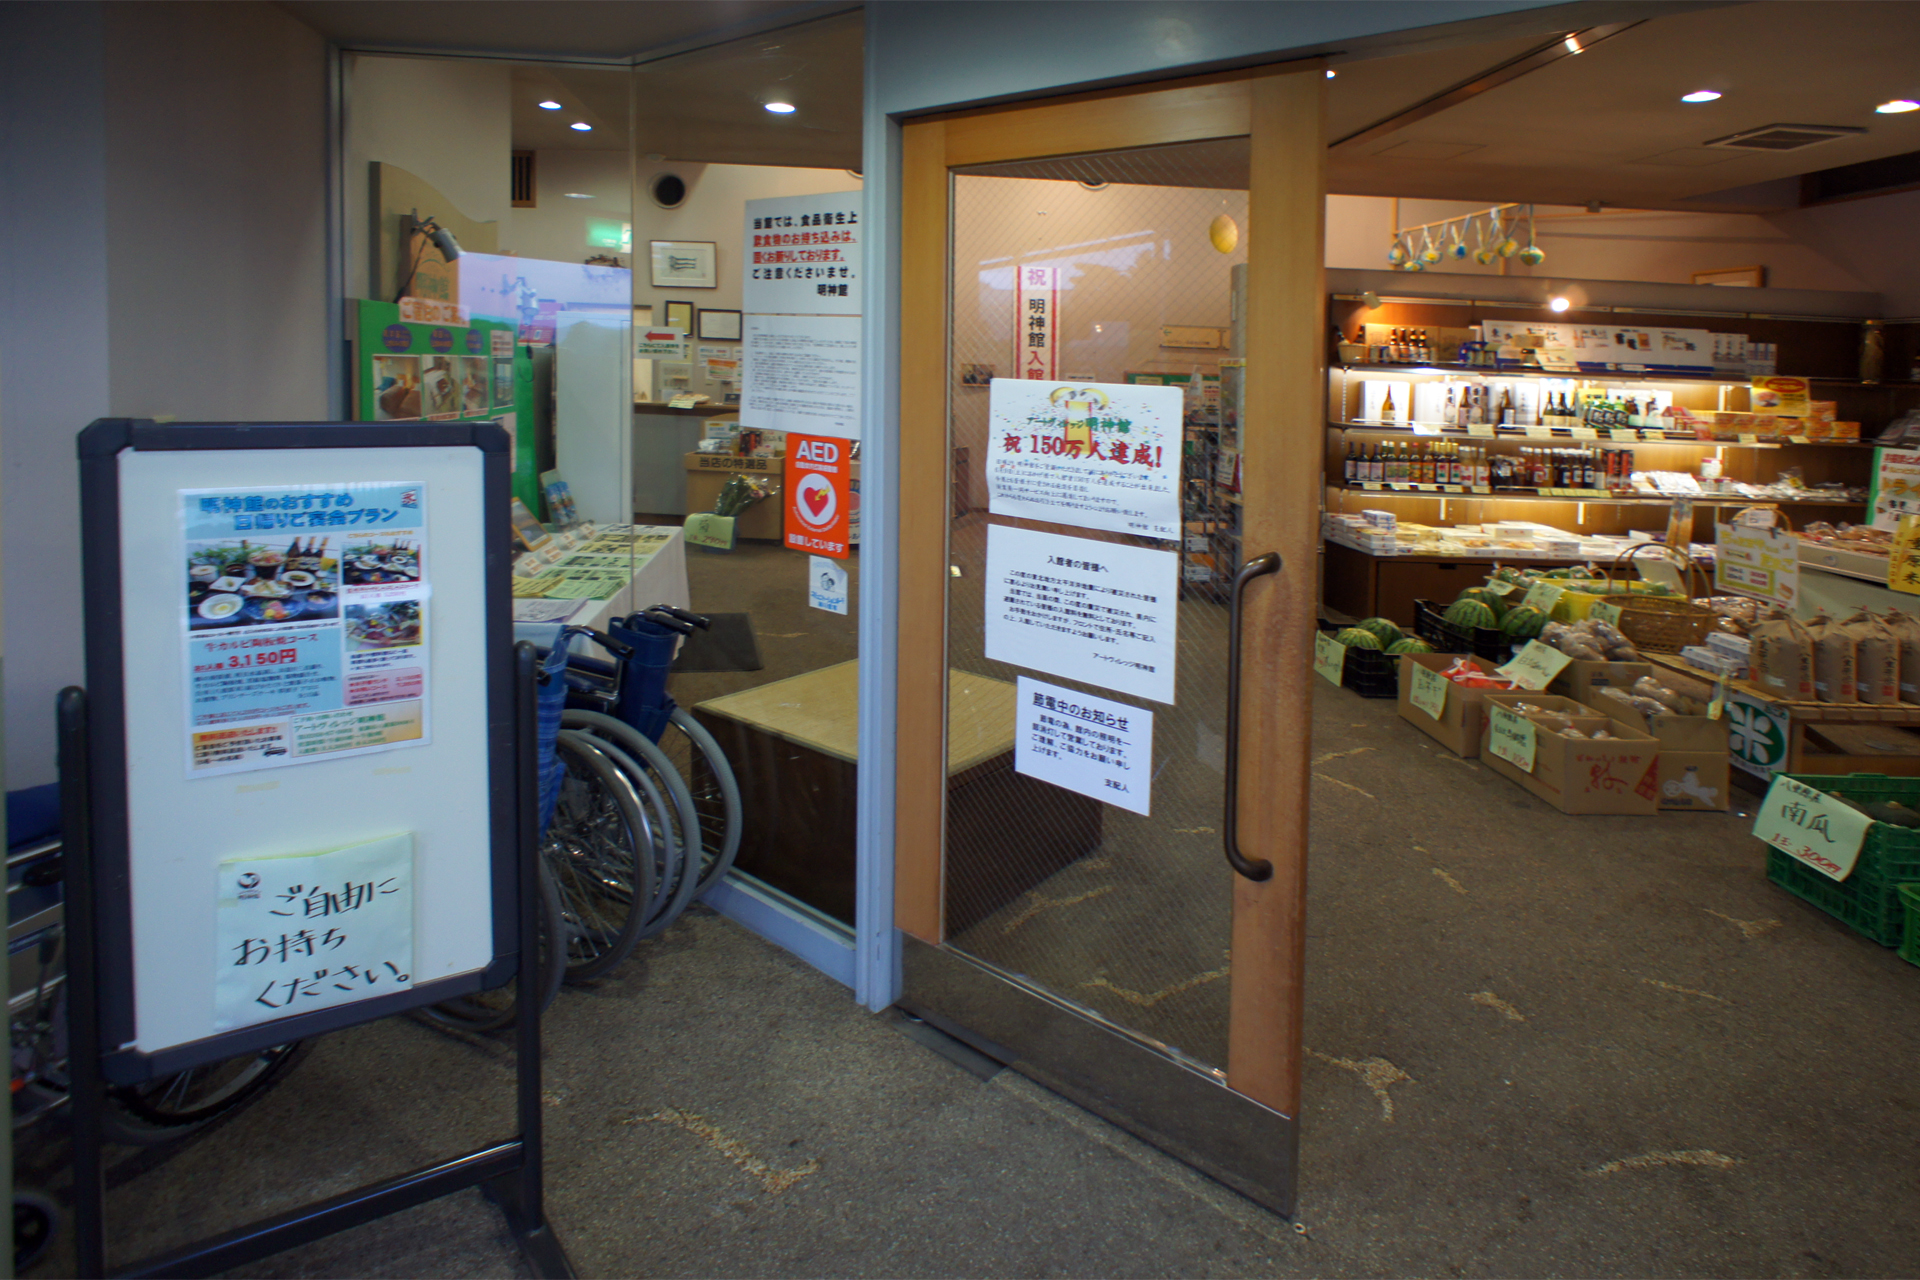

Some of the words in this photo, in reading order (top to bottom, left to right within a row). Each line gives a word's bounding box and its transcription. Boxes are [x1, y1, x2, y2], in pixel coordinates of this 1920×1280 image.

[752, 265, 856, 280] ご注意くださいませ。
[1027, 267, 1047, 287] 祝
[816, 283, 849, 297] 明神館
[795, 440, 840, 464] AED
[1002, 432, 1022, 454] 祝
[699, 456, 768, 470] 当店の特選品
[199, 492, 355, 515] 明神館のおすすめ
[233, 509, 400, 531] 日帰りご宴会プラン
[788, 533, 845, 554] 設置しています
[1047, 555, 1110, 574] 入館者の皆様へ
[228, 647, 298, 669] 3,150円
[1032, 692, 1130, 729] 節電中のお知らせ
[1031, 744, 1063, 760] 上げます。
[1104, 778, 1131, 793] 支配人
[1781, 801, 1837, 844] 南瓜
[1796, 845, 1843, 874] 300円
[268, 876, 401, 920] ご自由に
[231, 926, 348, 967] お持ち
[255, 960, 411, 1009] ください。
